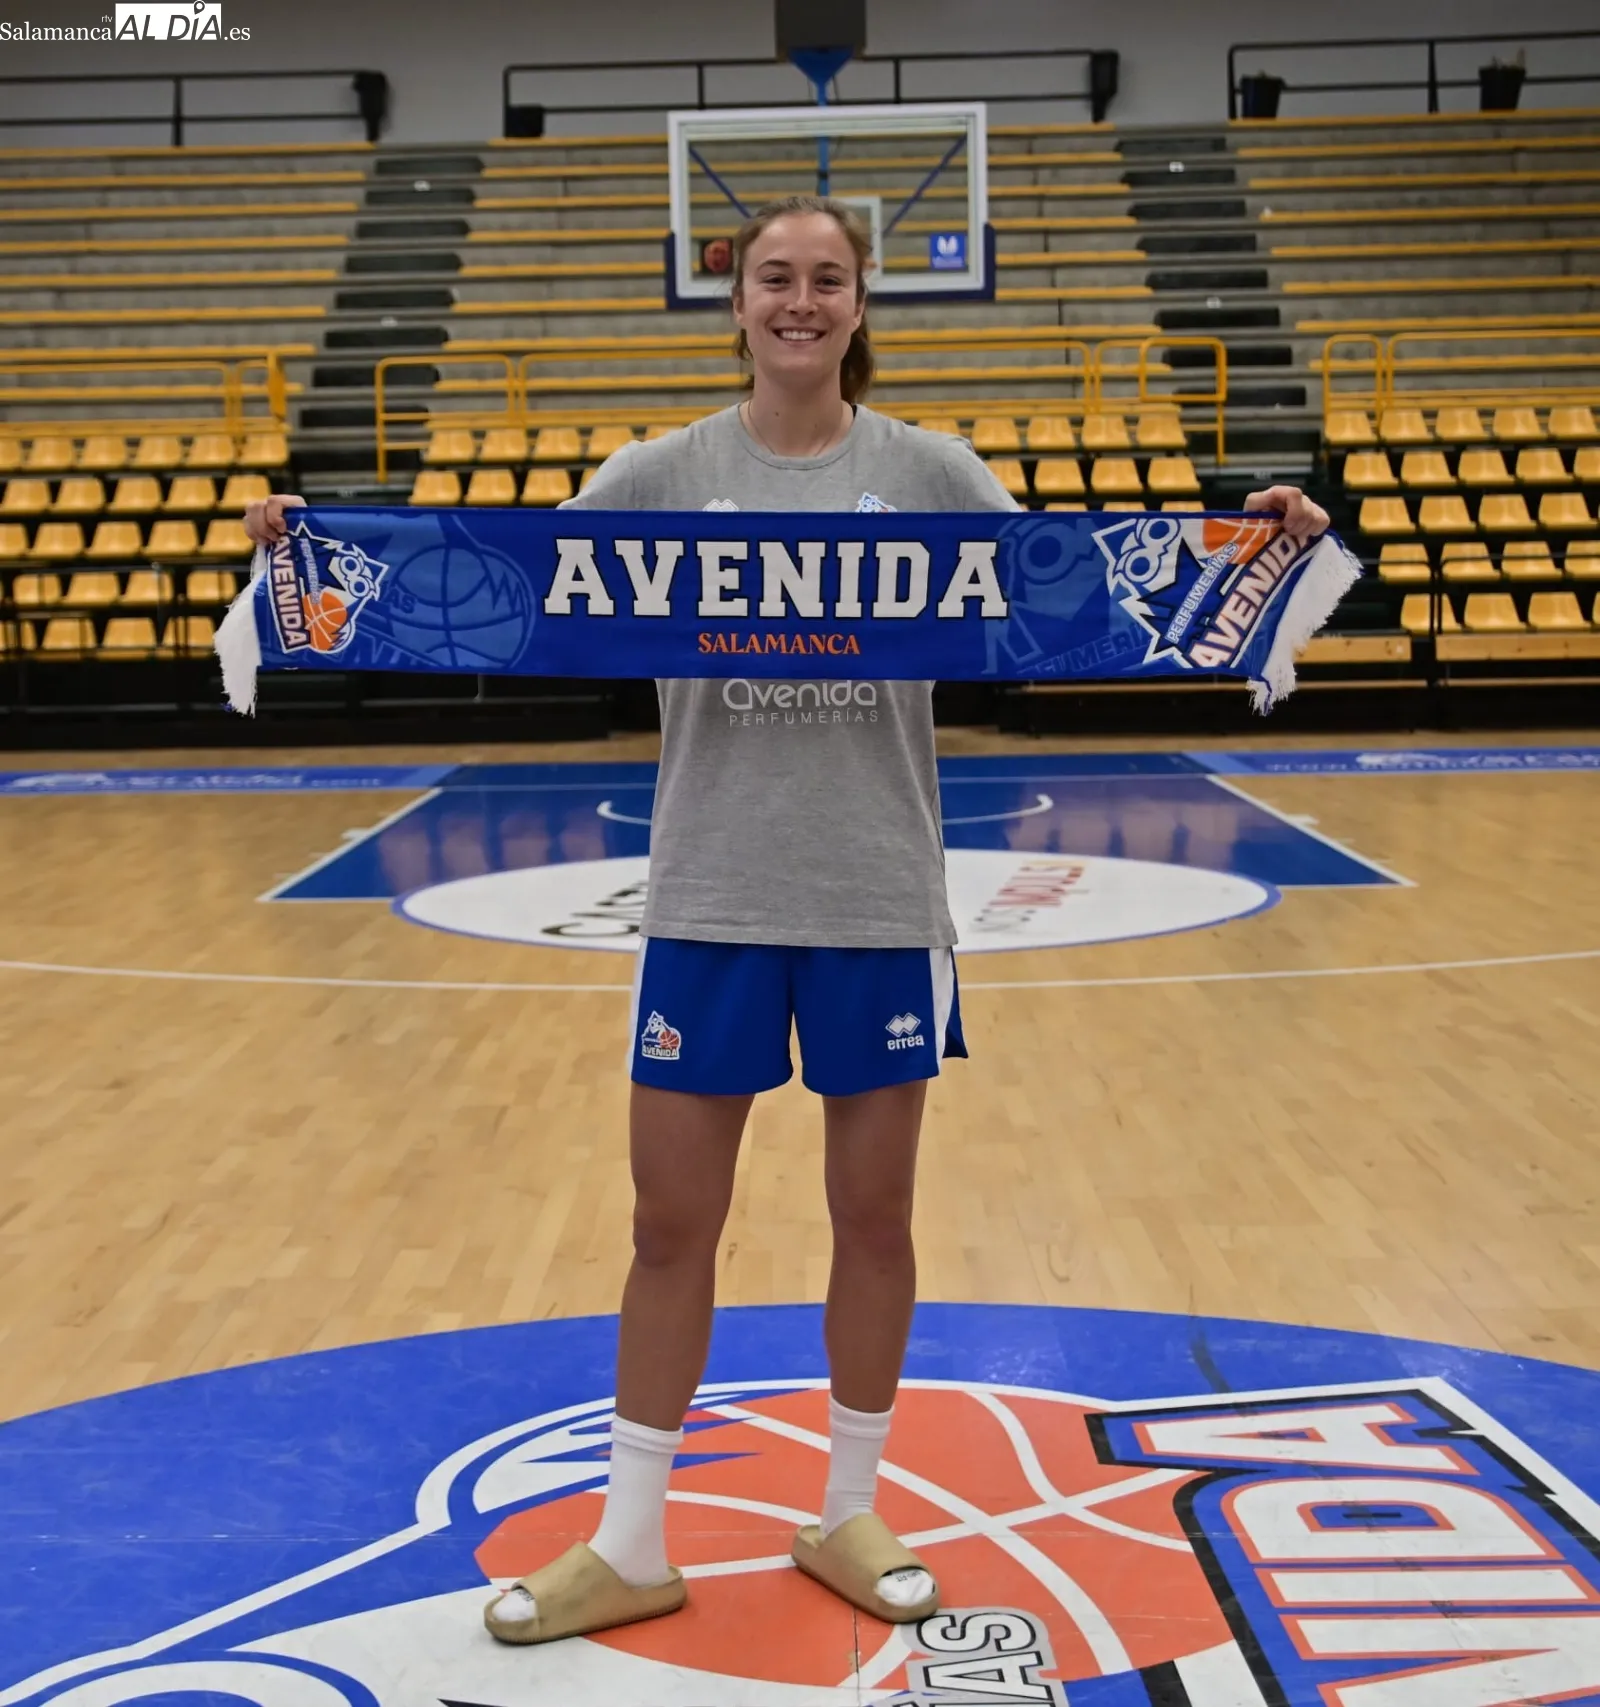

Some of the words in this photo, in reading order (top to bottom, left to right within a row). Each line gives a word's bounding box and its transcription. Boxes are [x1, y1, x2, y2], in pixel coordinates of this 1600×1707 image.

[544, 538, 1008, 619] AVENIDA
[1188, 532, 1300, 668] AVENID
[698, 633, 860, 656] SALAMANCA
[729, 708, 878, 727] PERFUMERÍAS
[642, 1044, 678, 1057] AVENIDA
[887, 1034, 925, 1050] errea
[910, 1611, 1059, 1707] AS
